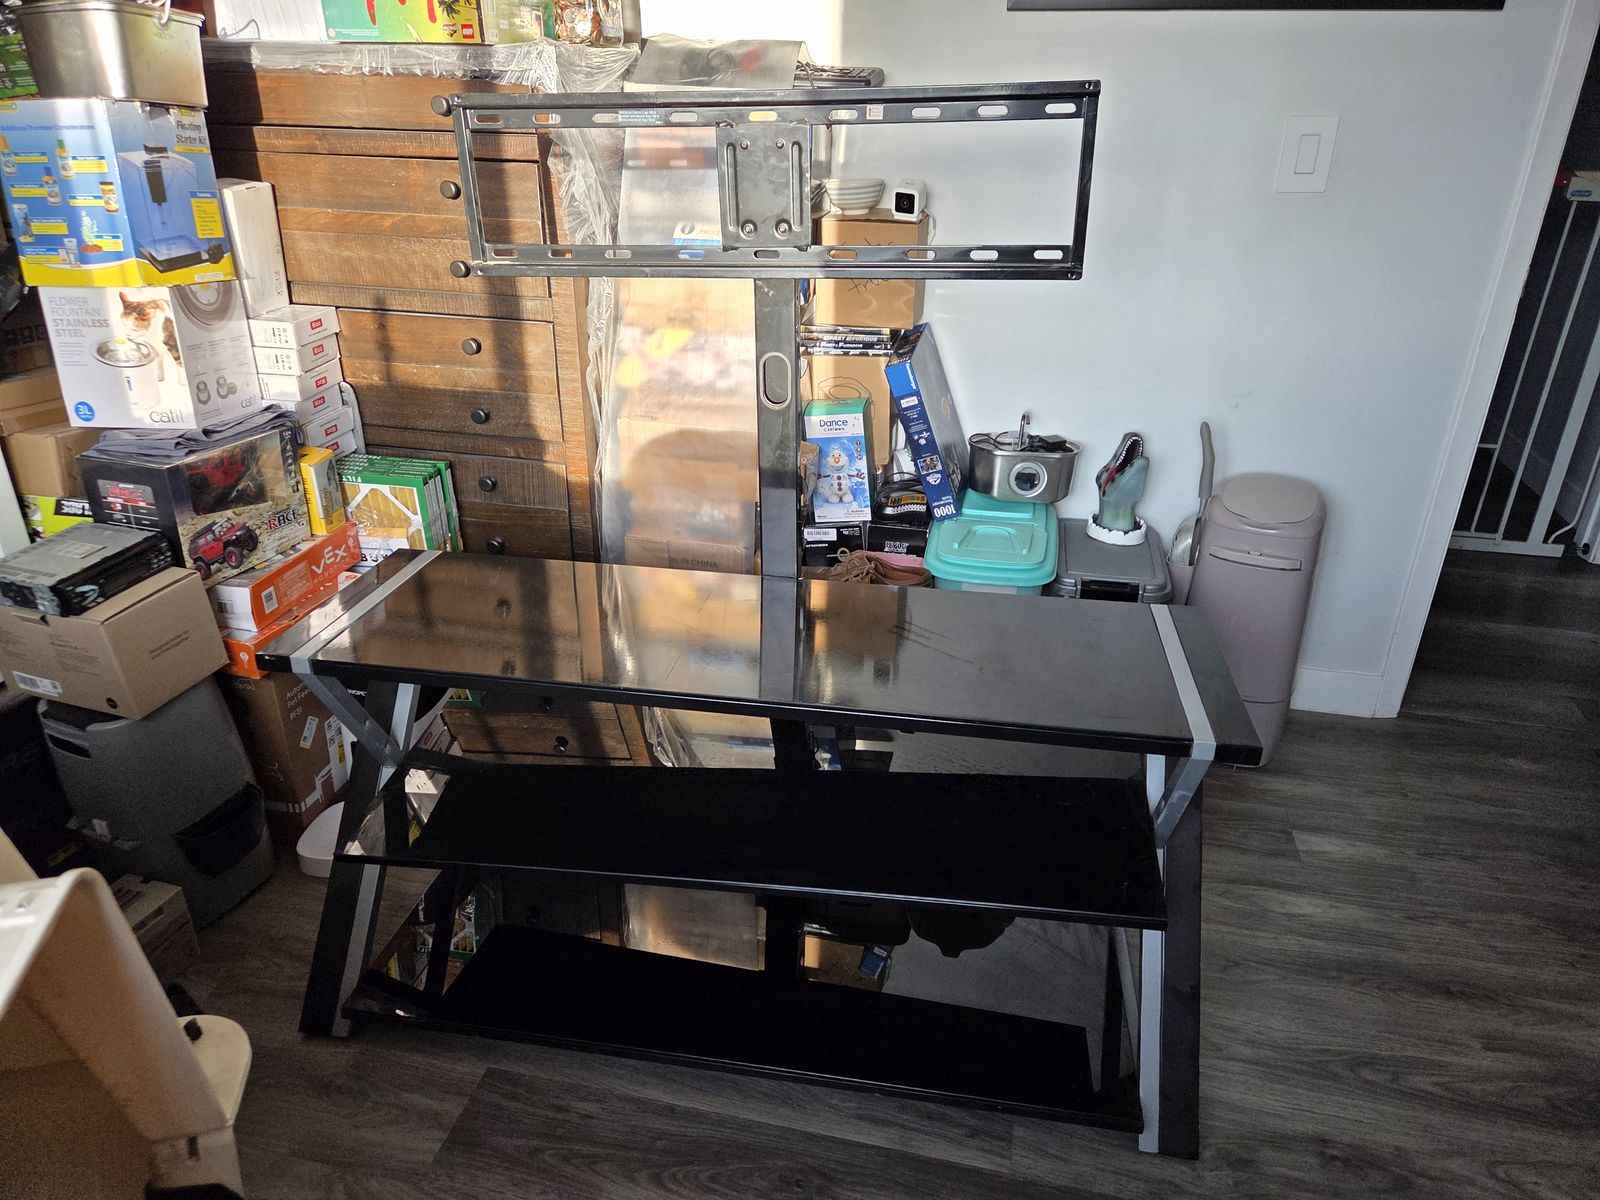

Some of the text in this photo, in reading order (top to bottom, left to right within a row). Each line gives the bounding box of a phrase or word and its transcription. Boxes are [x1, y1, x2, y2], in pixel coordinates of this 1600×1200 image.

[48, 296, 89, 307] FLOWER
[50, 307, 104, 318] FOUNTAIN
[53, 318, 110, 328] STAINLESS
[55, 328, 87, 338] STEEL
[77, 404, 92, 415] 3L
[149, 408, 185, 424] catit
[819, 419, 848, 427] Dance
[342, 475, 362, 483] FILT
[934, 504, 956, 518] 1000
[266, 509, 298, 531] RACE
[311, 544, 348, 575] VEX
[690, 558, 719, 569] CHINA
